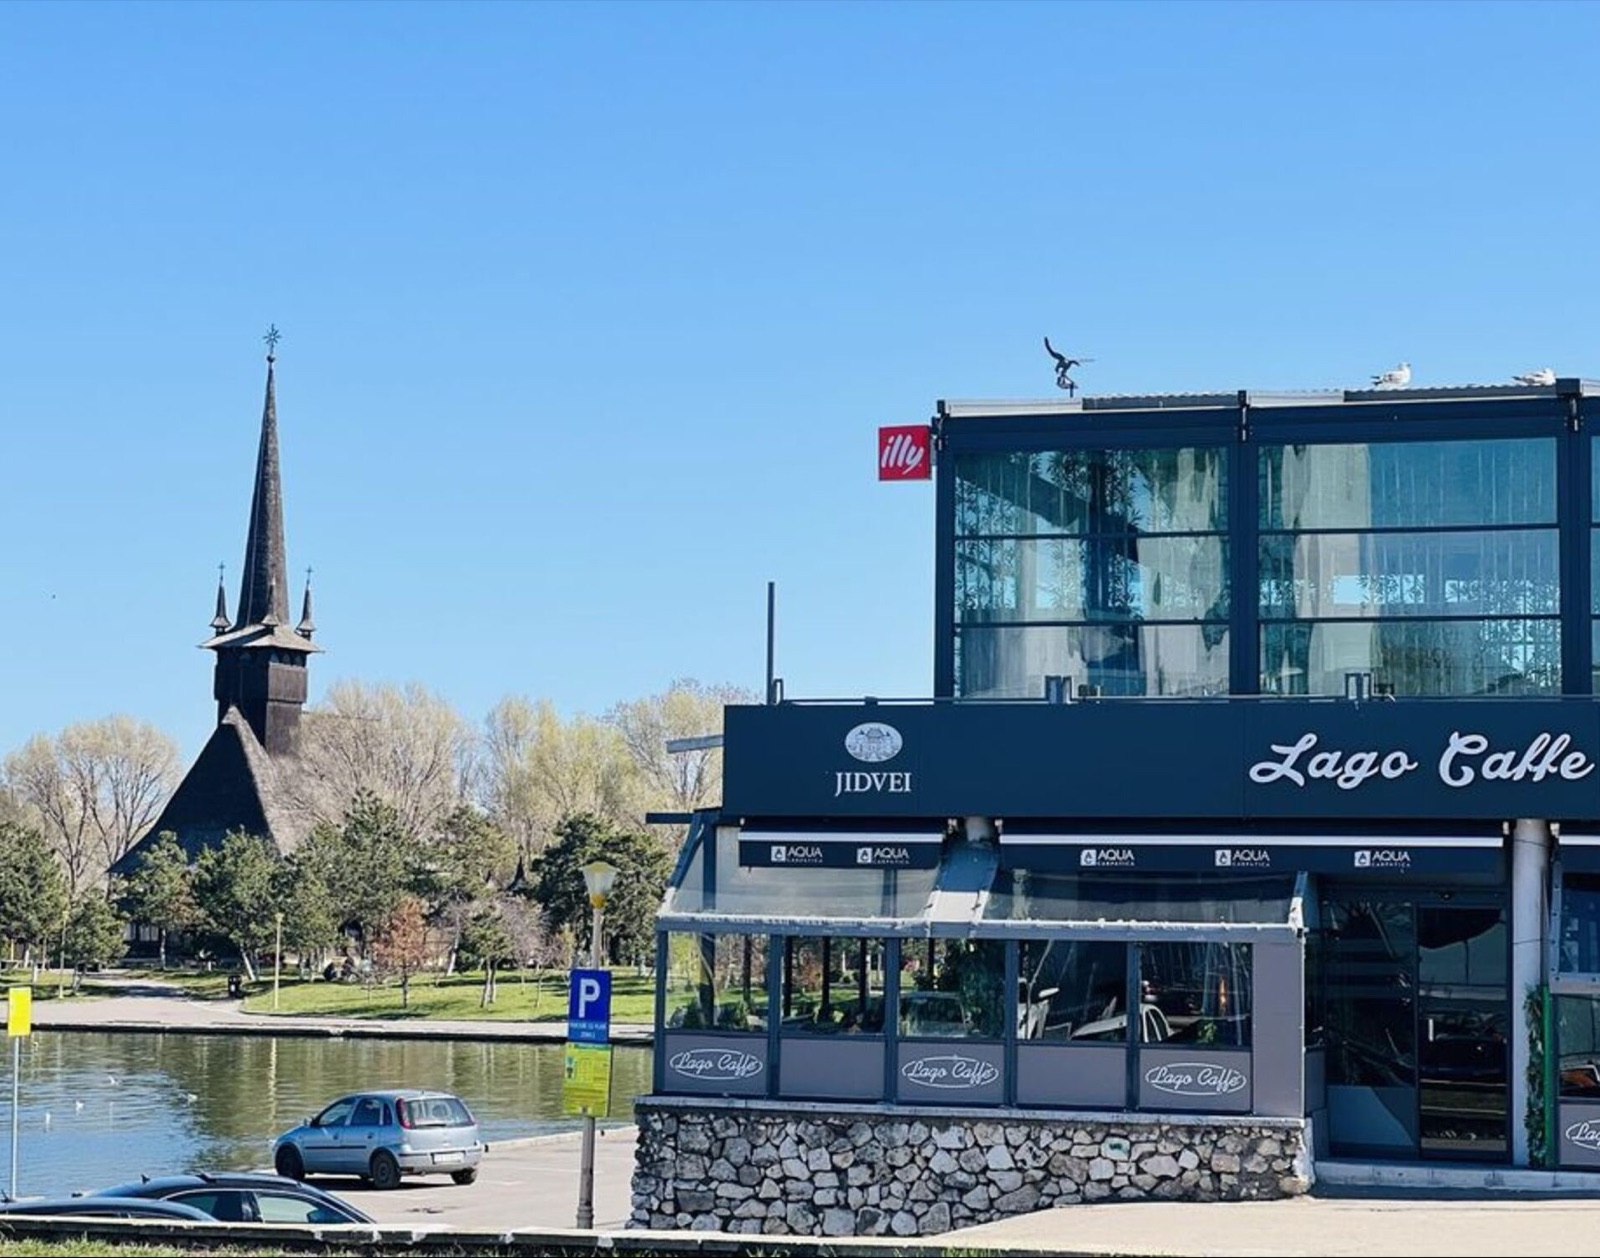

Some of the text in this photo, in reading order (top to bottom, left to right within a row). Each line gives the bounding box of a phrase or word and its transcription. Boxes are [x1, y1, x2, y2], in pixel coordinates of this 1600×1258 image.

[881, 433, 925, 475] illy
[1248, 731, 1596, 790] Lago Caffe
[834, 772, 913, 797] JIDVEI
[786, 845, 823, 858] AQUA
[873, 847, 910, 860] AQUA
[1097, 849, 1135, 861] AQUA
[1232, 849, 1271, 862] AQUA
[1371, 850, 1411, 861] AQUA
[578, 978, 601, 1018] P
[675, 1052, 713, 1075] Lago
[907, 1060, 948, 1084] Lago
[1150, 1066, 1193, 1090] Lago
